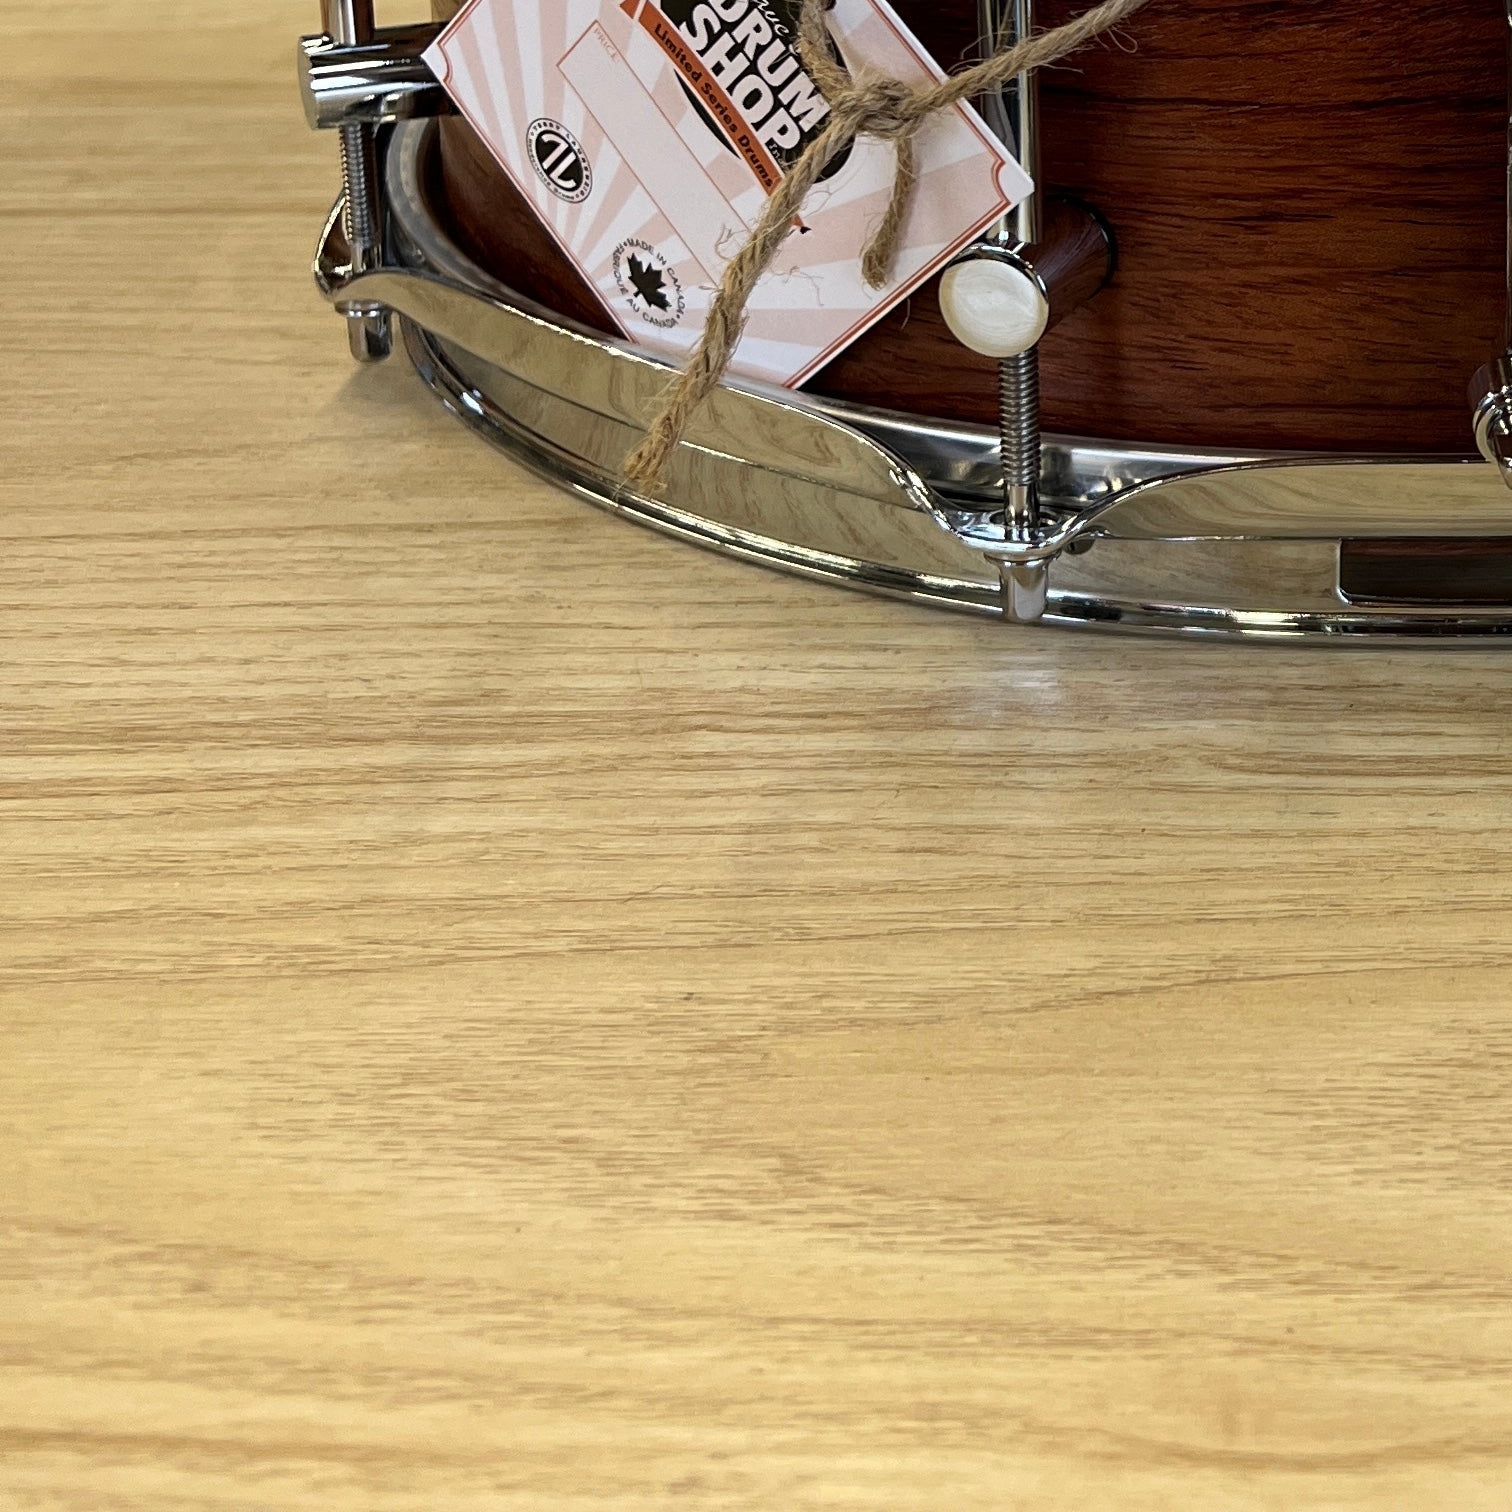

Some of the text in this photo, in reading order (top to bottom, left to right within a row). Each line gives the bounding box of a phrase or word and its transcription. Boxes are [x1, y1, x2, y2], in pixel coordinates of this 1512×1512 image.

[593, 27, 620, 63] PRICE
[679, 3, 801, 150] SHOP
[653, 22, 774, 188] Limited Series Drums
[626, 237, 686, 315] MADE IN CANADA
[626, 297, 641, 313] AU
[642, 311, 679, 329] CANADA
